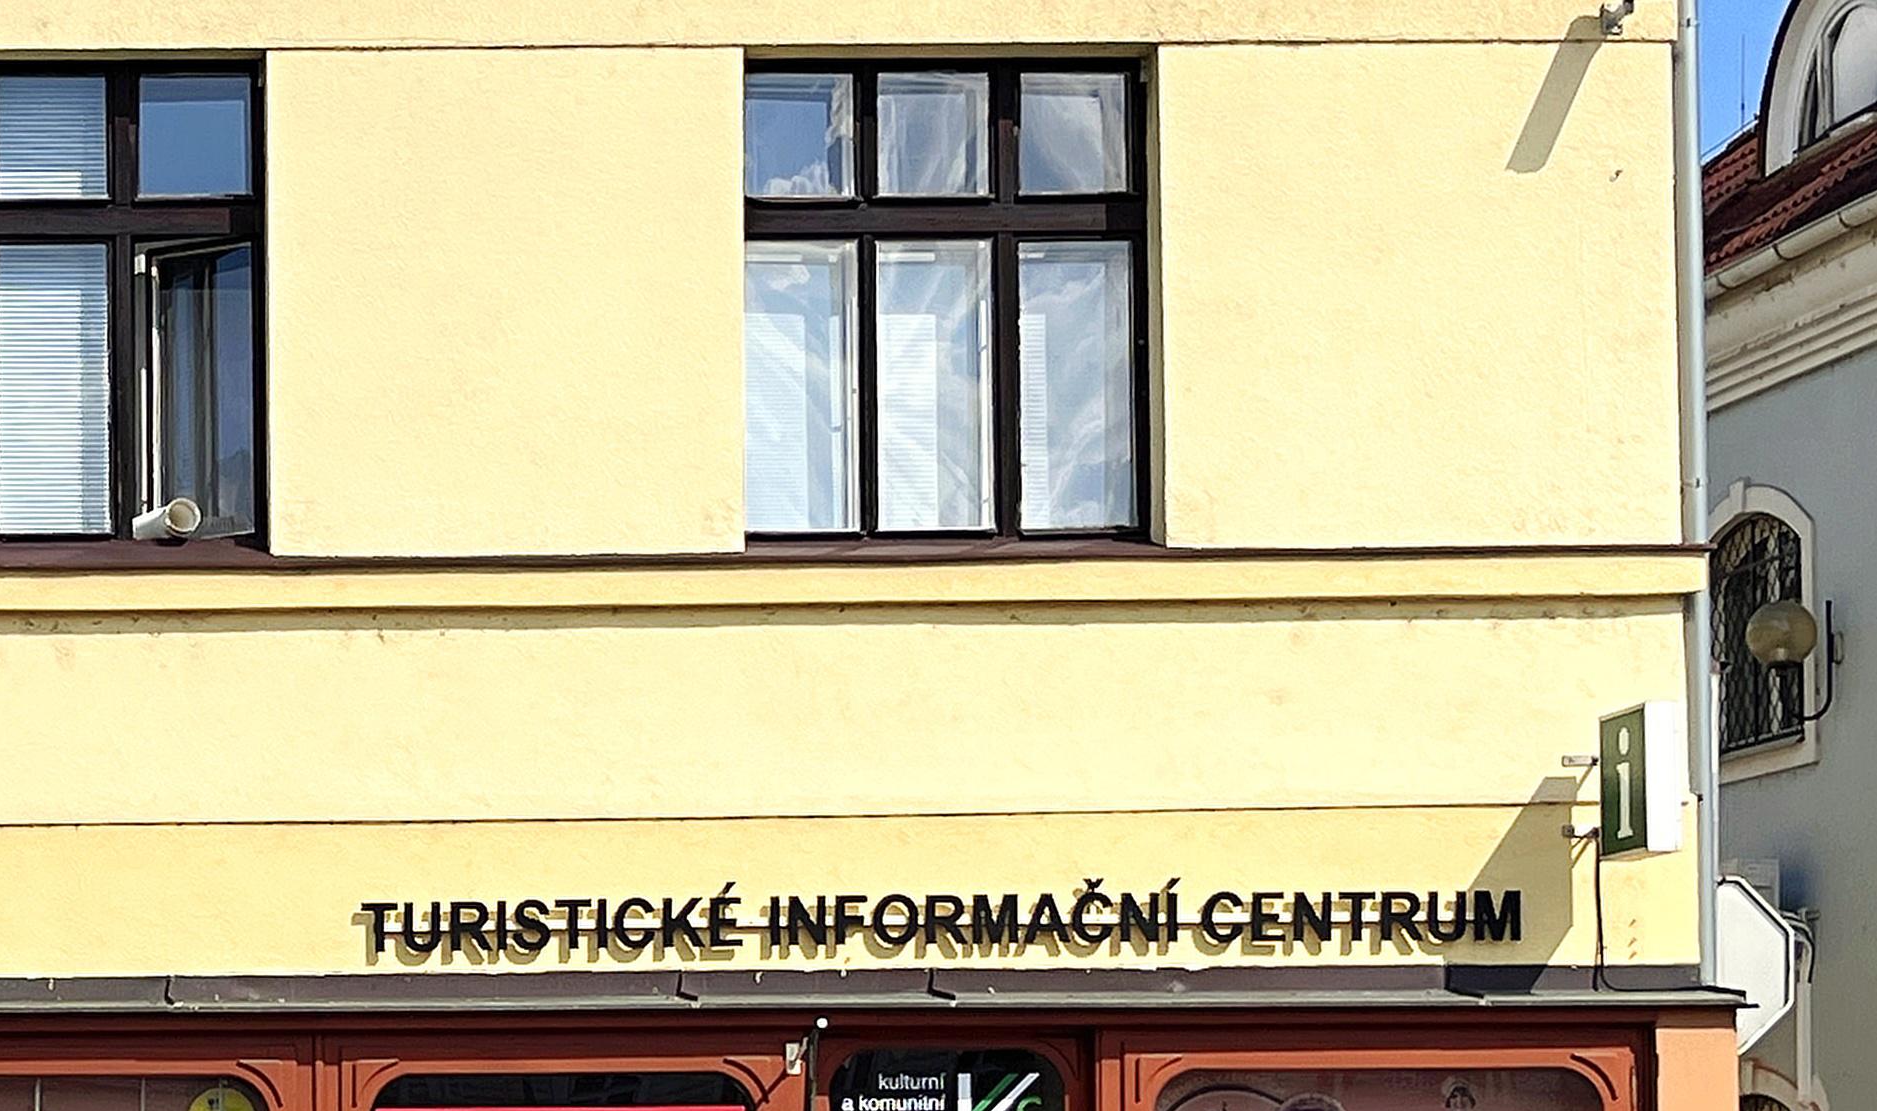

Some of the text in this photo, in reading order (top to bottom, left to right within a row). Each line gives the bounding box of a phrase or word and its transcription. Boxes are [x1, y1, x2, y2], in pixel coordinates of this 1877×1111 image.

[360, 876, 1522, 954] TURISTICKÉ INFORMAČNÍ CENTRUM
[878, 1072, 947, 1090] kulturní
[841, 1094, 946, 1111] a komunitní
